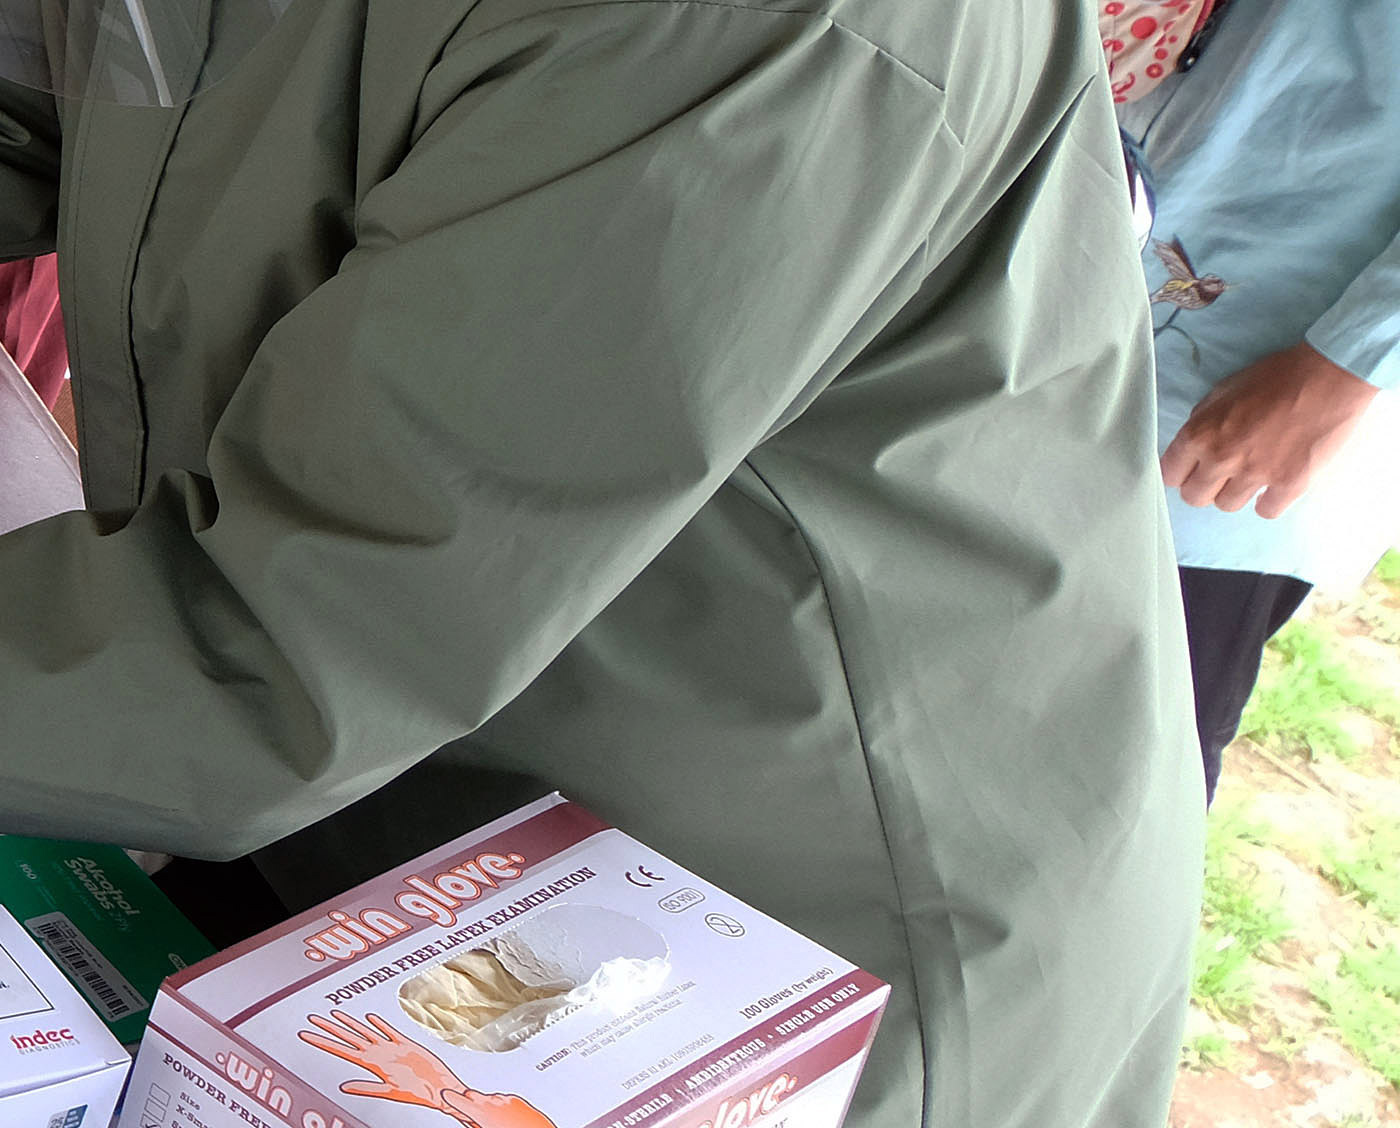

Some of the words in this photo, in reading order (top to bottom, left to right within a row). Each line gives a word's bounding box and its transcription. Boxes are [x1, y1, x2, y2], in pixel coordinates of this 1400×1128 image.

[64, 858, 115, 911] Swabs
[77, 856, 140, 916] Alcohol
[324, 965, 399, 1005] POWDER
[393, 944, 447, 973] FREE
[436, 918, 493, 952] LATEX
[485, 866, 598, 928] EXAMINATION
[739, 1004, 763, 1019] 100
[758, 987, 794, 1009] Gloves
[831, 982, 861, 1002] ONLY
[10, 1028, 74, 1049] indec
[162, 1052, 227, 1105] POWDER
[179, 1091, 201, 1110] Size
